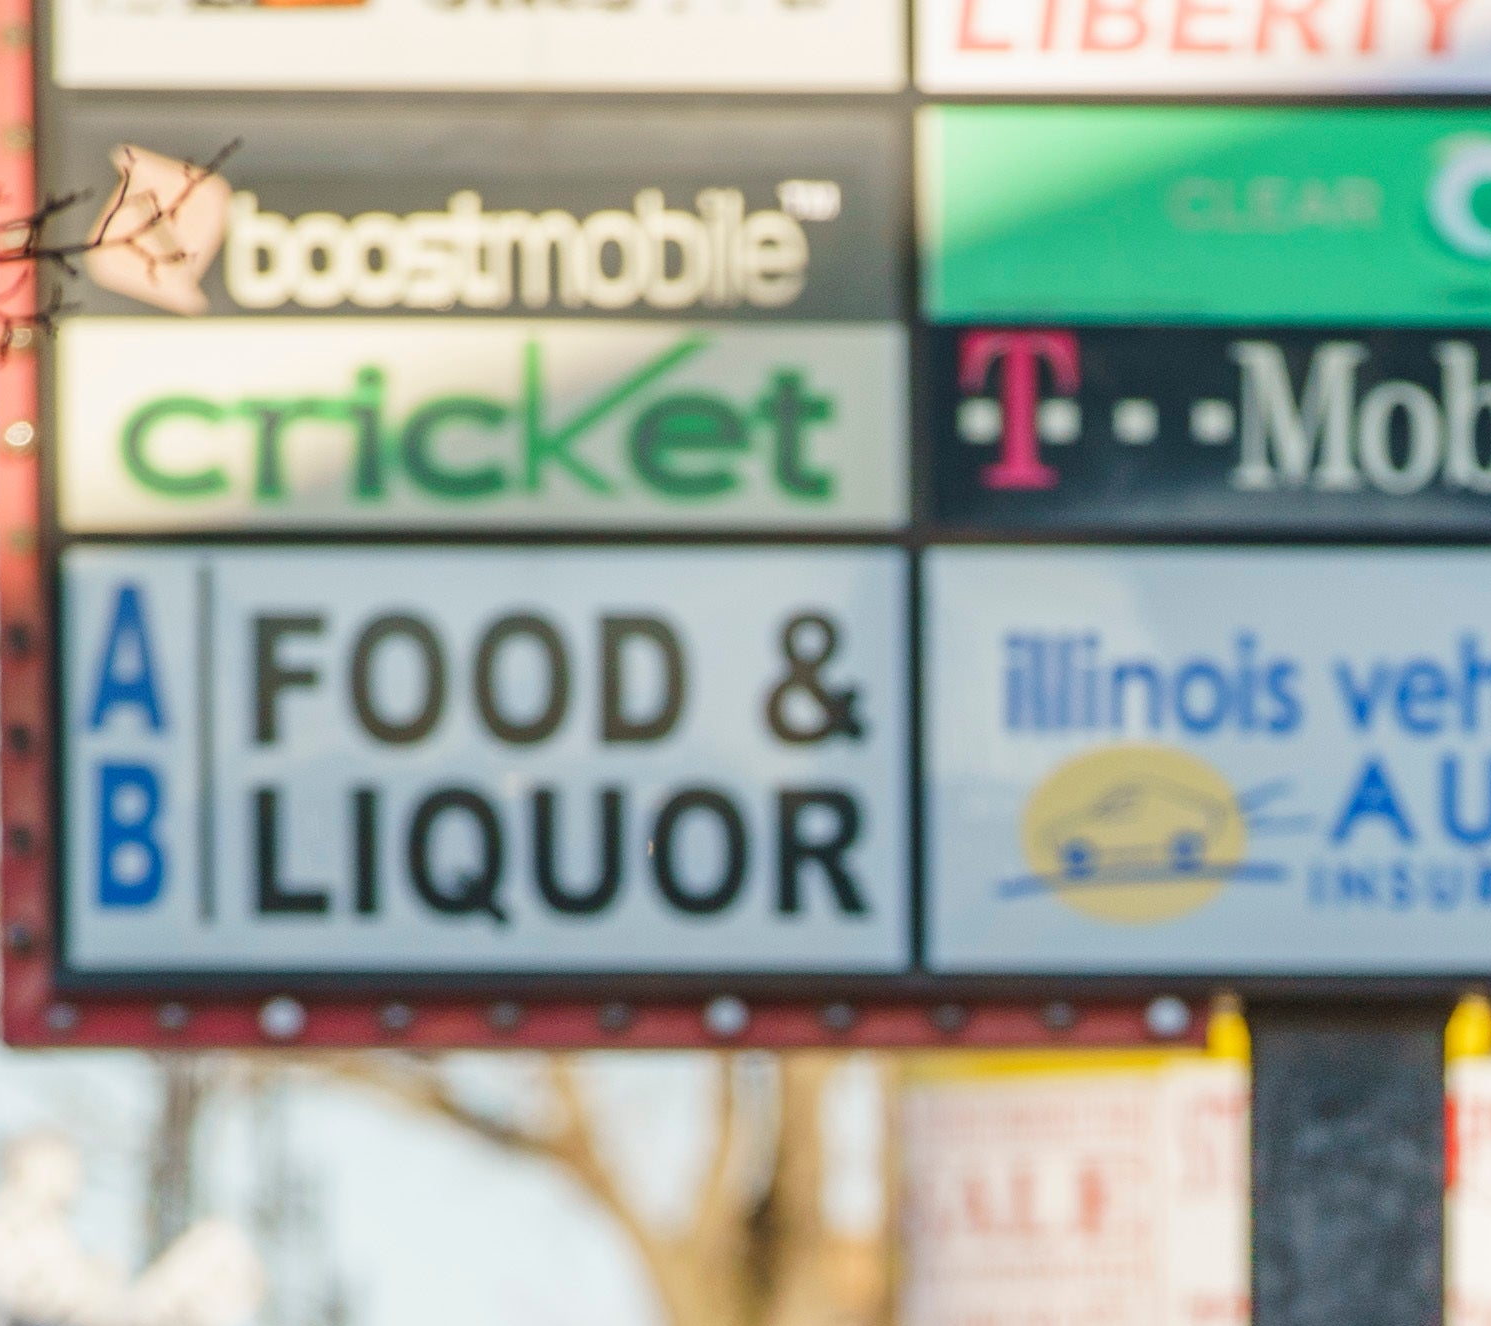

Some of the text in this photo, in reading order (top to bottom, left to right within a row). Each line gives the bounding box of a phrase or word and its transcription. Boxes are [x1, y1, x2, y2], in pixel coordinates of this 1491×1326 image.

[121, 332, 836, 503] cricket
[251, 612, 866, 745] FOOD &
[1003, 629, 1304, 736] illinois
[253, 787, 868, 928] LIQUOR
